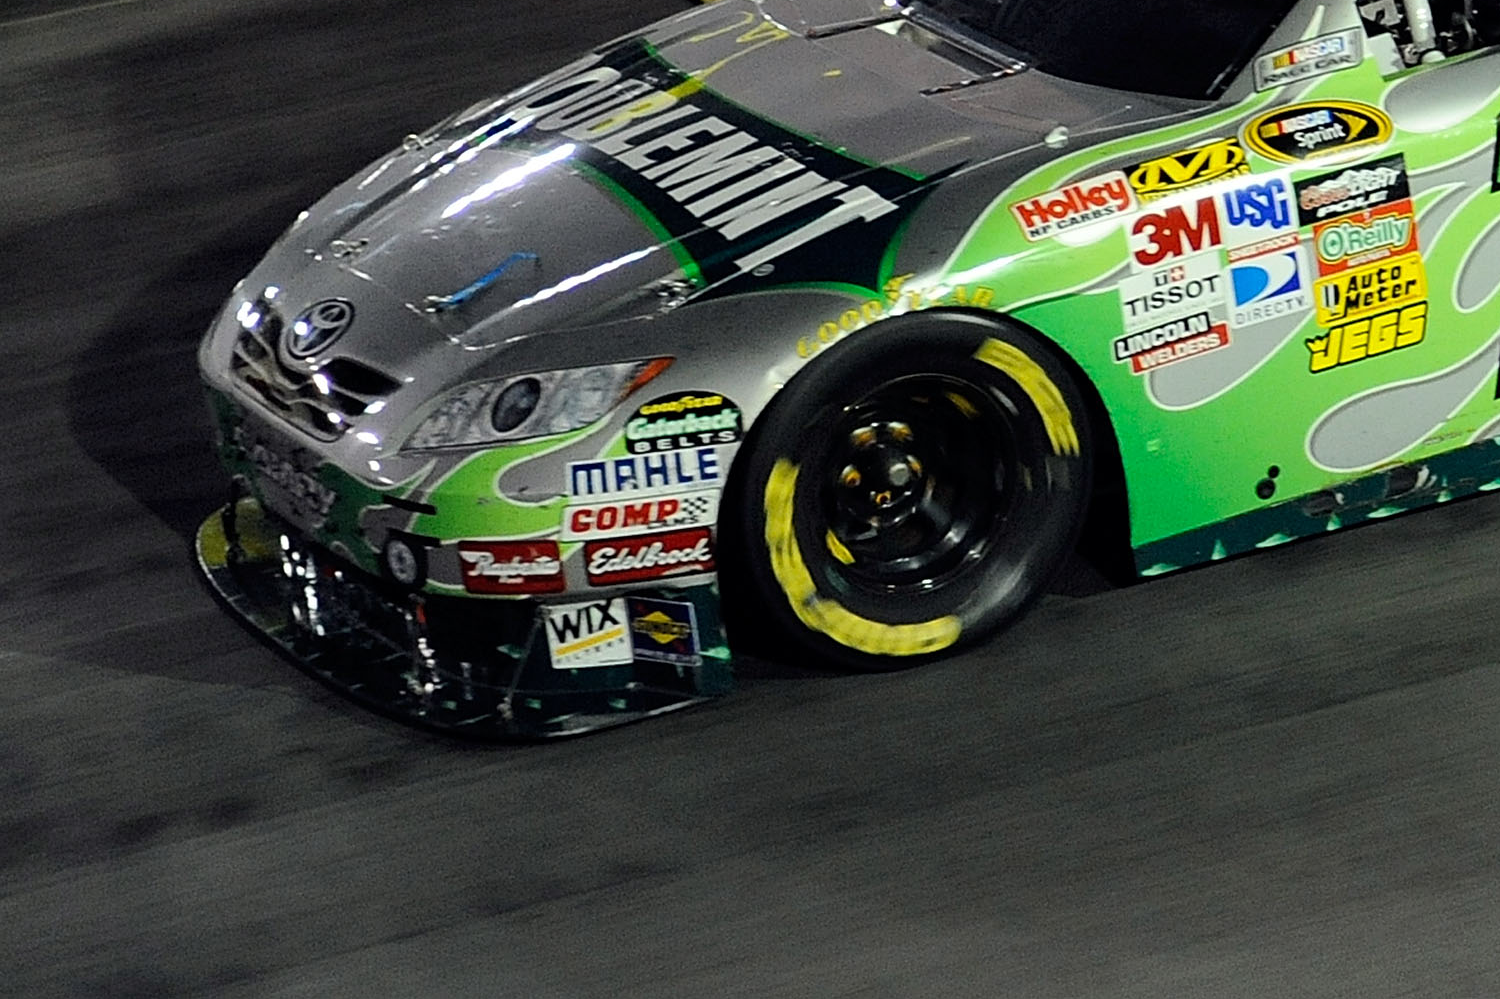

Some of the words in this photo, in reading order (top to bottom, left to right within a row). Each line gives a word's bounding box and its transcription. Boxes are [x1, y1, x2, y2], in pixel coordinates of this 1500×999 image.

[1263, 64, 1311, 84] RACE
[1292, 123, 1346, 149] Sprint
[514, 65, 899, 273] OUBLEMINT
[1015, 178, 1131, 228] Holley
[1057, 206, 1117, 230] CARBS
[1222, 177, 1292, 230] USG
[1316, 189, 1390, 218] POLE
[1132, 196, 1222, 266] 3M
[1319, 216, 1412, 261] O'Reilly
[1124, 274, 1221, 317] TISSOT
[1344, 278, 1417, 311] Meter
[1346, 265, 1402, 294] Auto
[1235, 295, 1306, 326] DIRECTV
[1116, 313, 1211, 360] LINCOLN
[1139, 332, 1222, 370] WELDERS
[1309, 300, 1429, 374] JEGS
[626, 409, 742, 441] Gatorback
[633, 430, 737, 453] BELTS
[571, 448, 720, 497] MAHLE
[570, 499, 680, 533] COMP
[588, 538, 713, 575] Edelbrock
[549, 600, 621, 644] WIX
